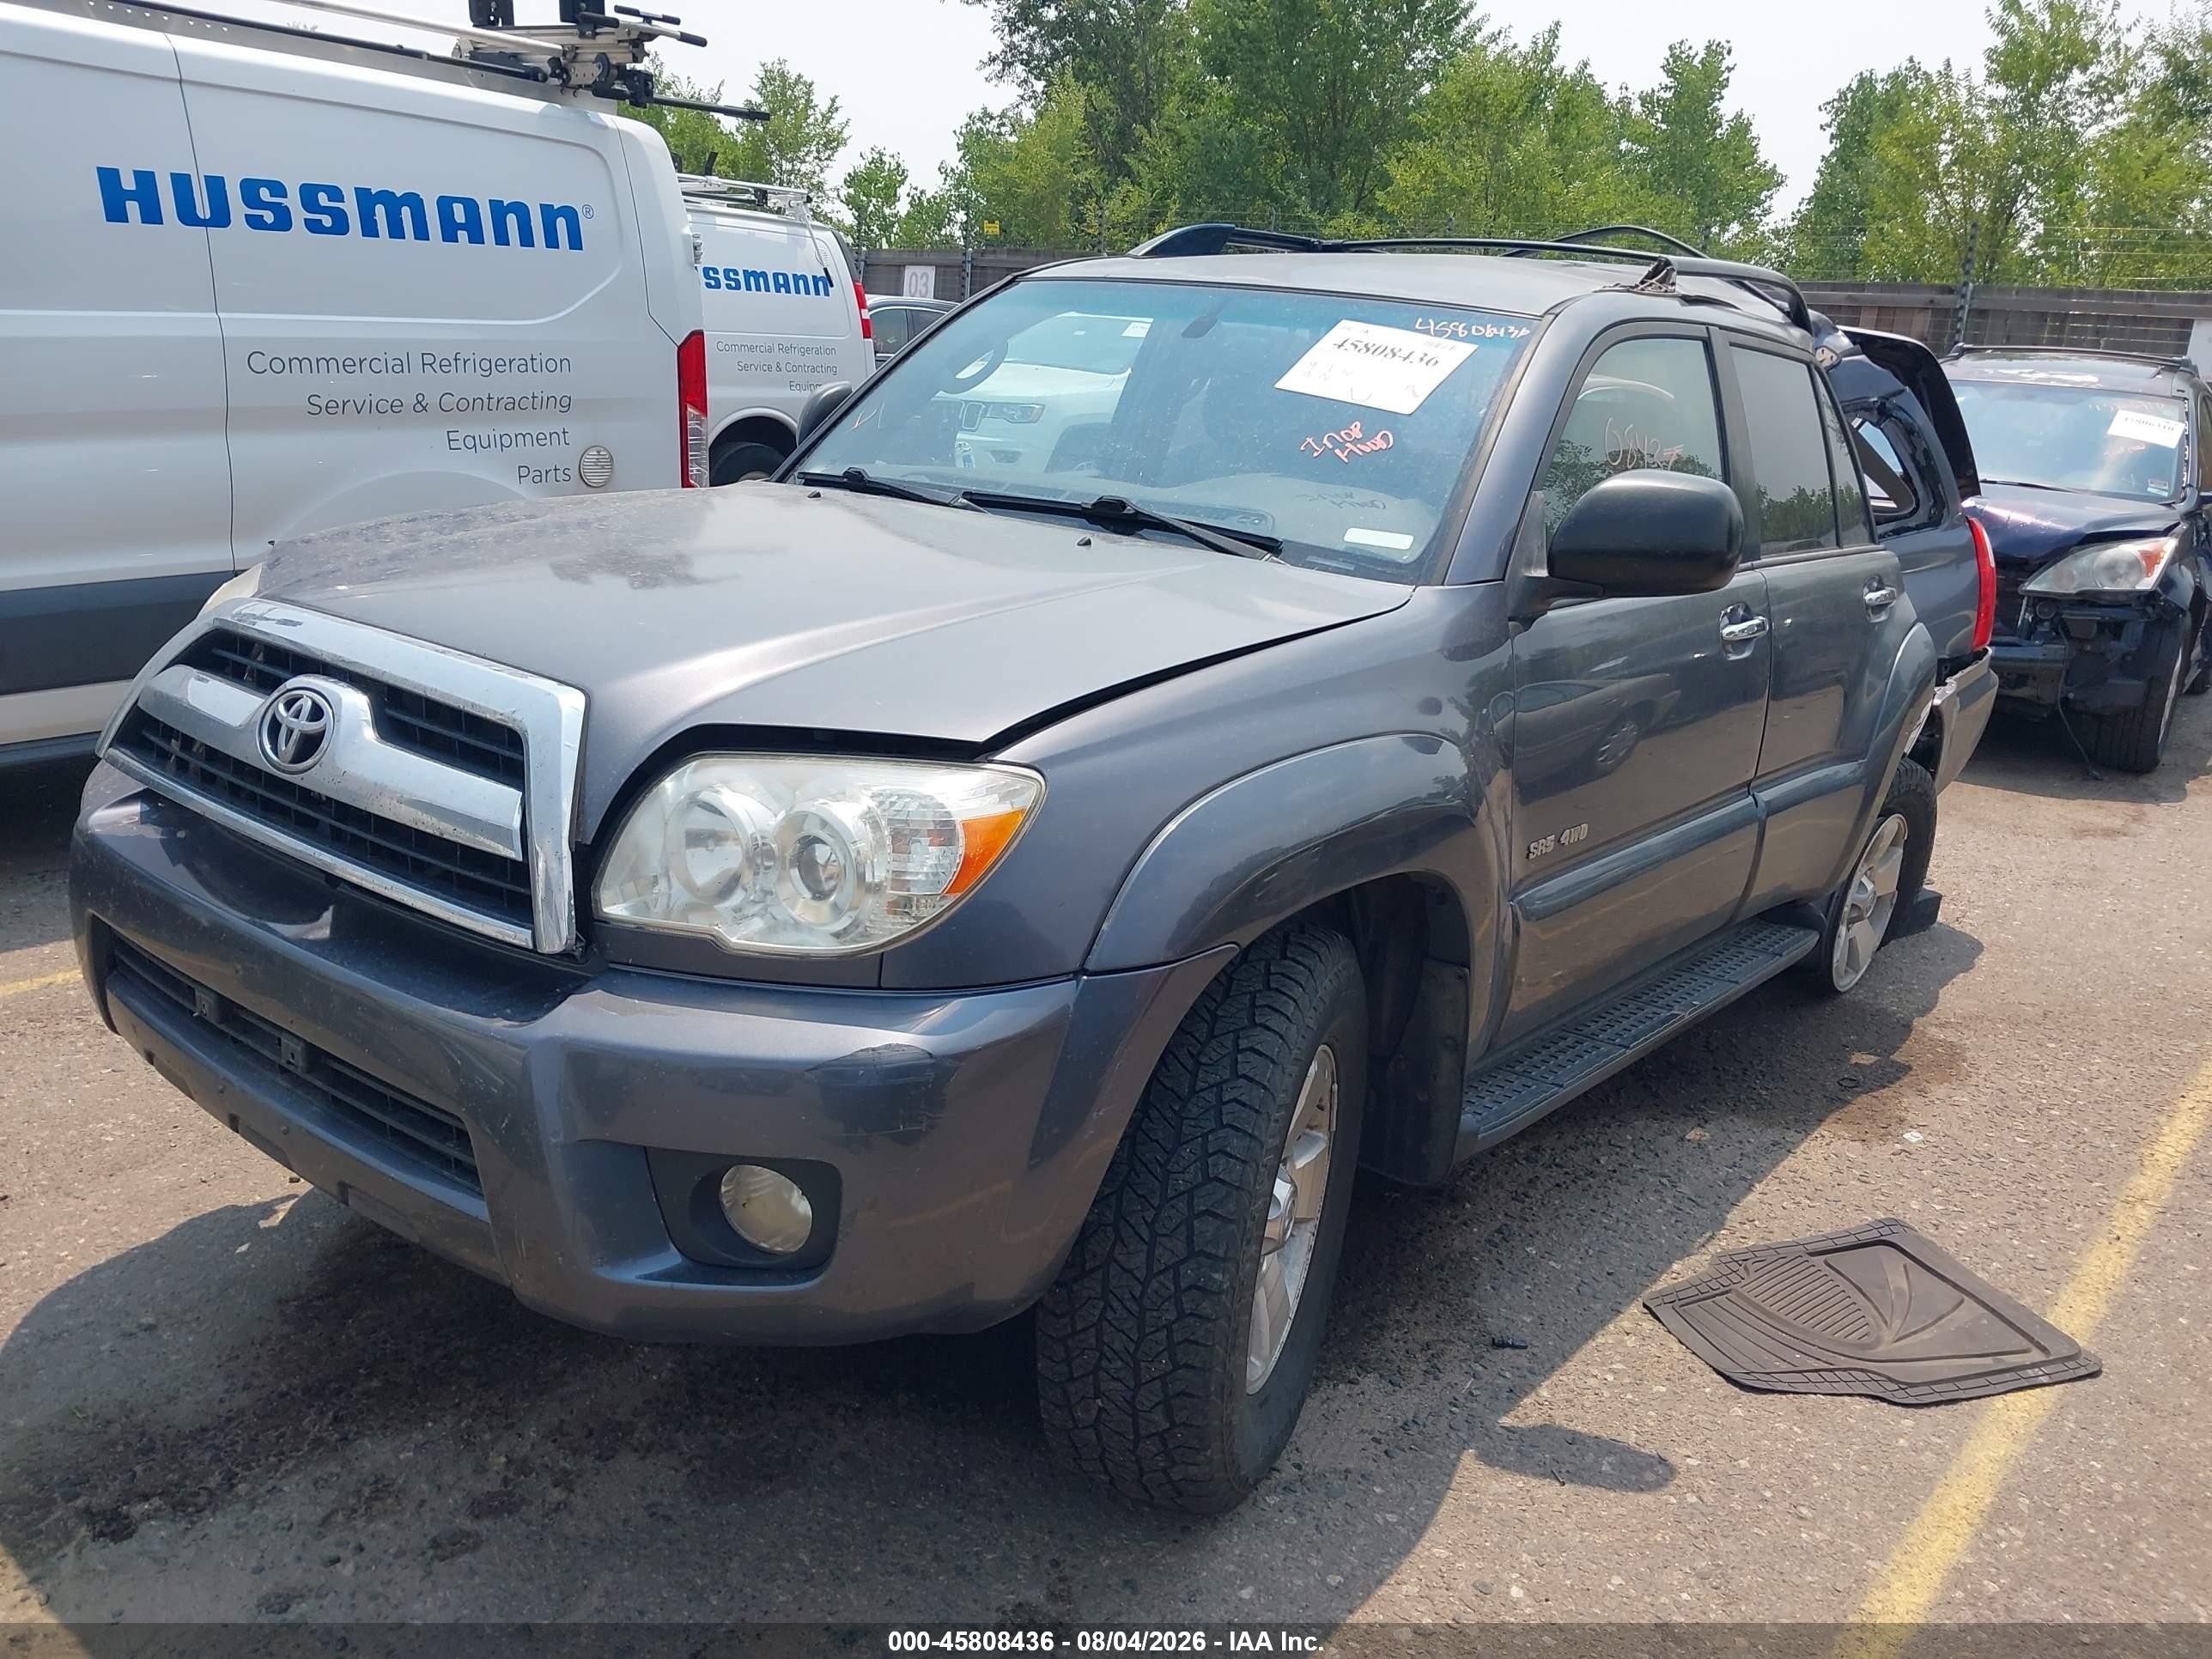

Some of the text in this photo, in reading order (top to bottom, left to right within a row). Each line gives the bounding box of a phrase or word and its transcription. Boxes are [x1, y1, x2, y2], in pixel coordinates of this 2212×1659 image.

[909, 271, 929, 297] 03
[716, 340, 836, 357] Commercial Refrigeration
[1333, 337, 1440, 368] 45808436
[246, 351, 571, 378] Commercial Refrigeration
[737, 361, 837, 376] Service & Contracting
[789, 380, 823, 392] Equip
[307, 391, 572, 416] Service & Contracting
[447, 427, 570, 453] Equipment
[518, 464, 572, 485] Parts
[1528, 823, 1589, 860] SR5 4WD
